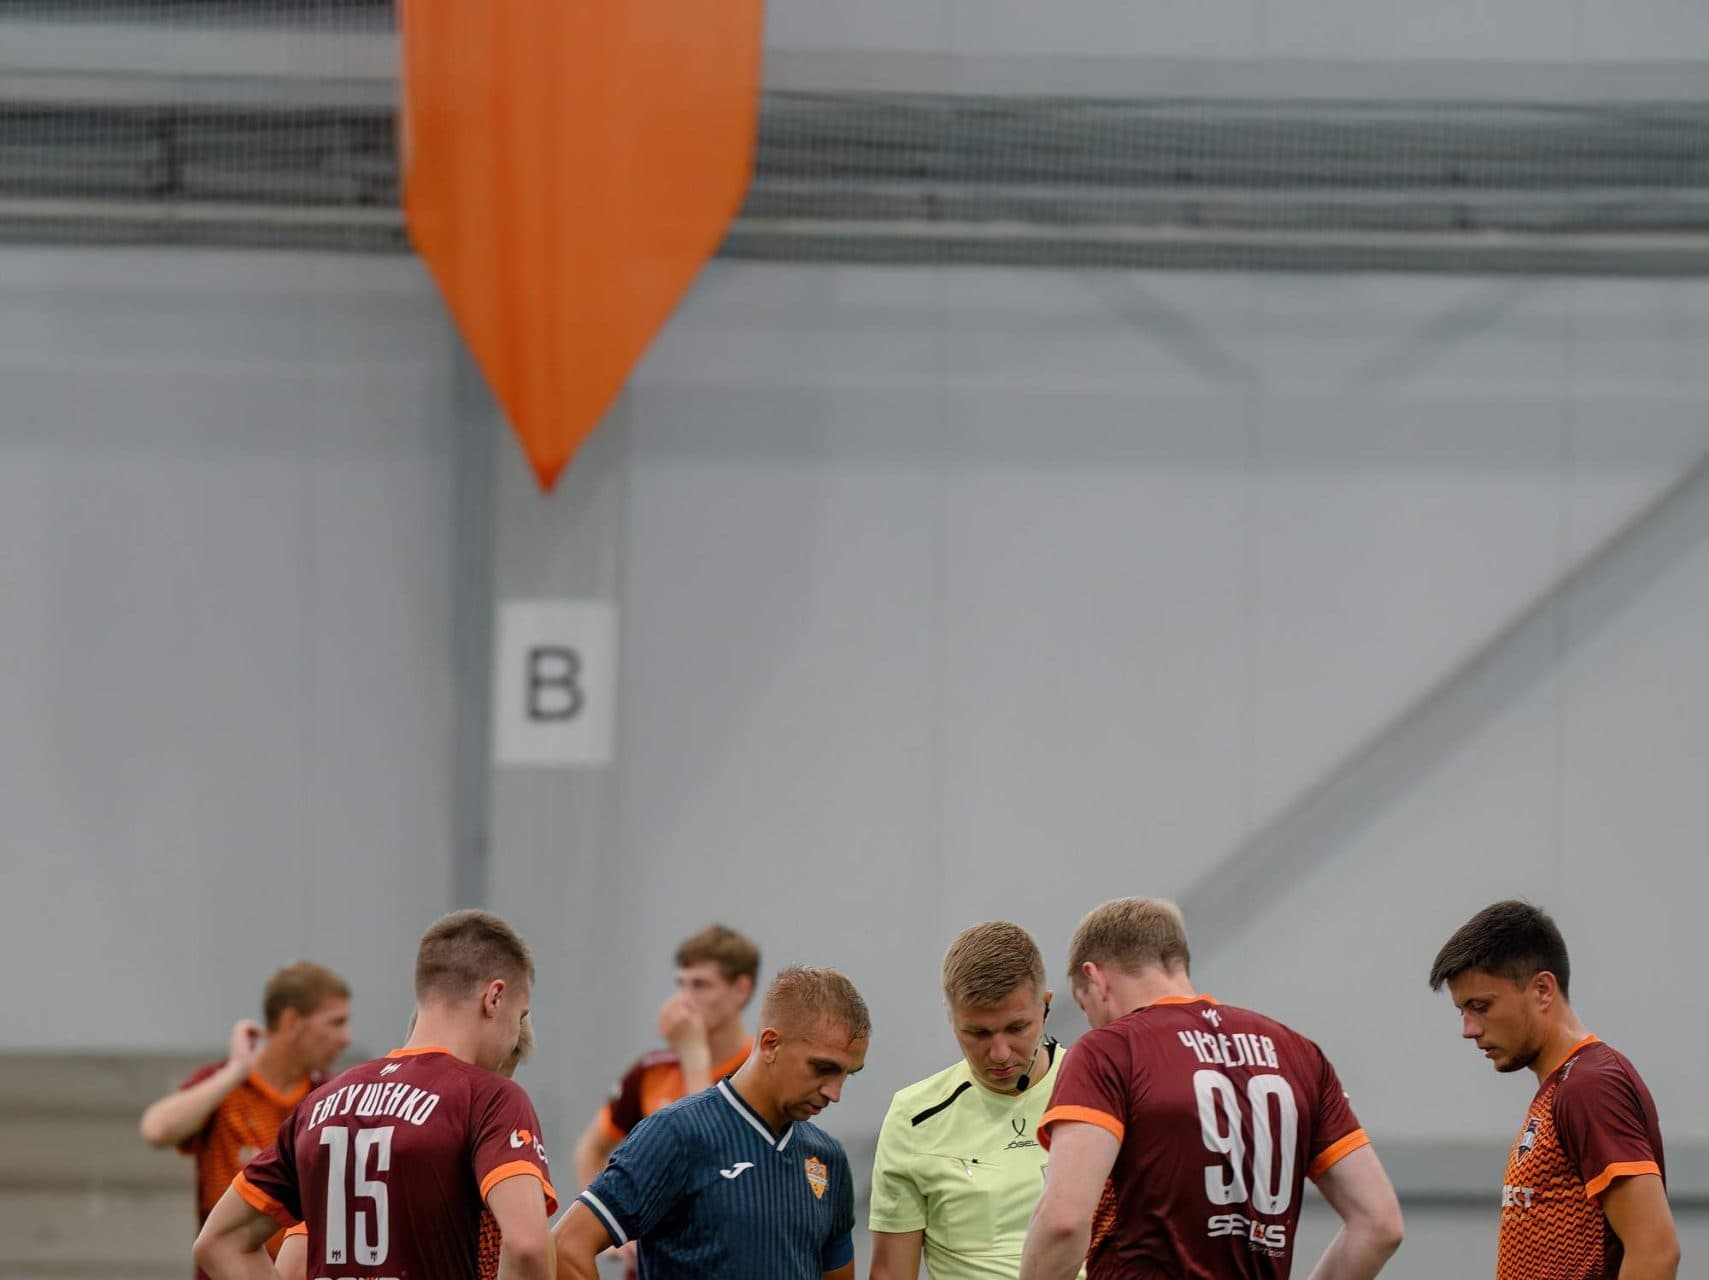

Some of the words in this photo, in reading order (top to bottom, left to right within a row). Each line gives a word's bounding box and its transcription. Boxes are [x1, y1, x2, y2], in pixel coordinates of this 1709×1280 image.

[527, 645, 585, 722] B
[308, 1083, 440, 1131] ЕВТУШЕНКО
[1193, 1069, 1298, 1215] 90
[319, 1126, 395, 1266] 15
[1207, 1213, 1286, 1248] SEUS
